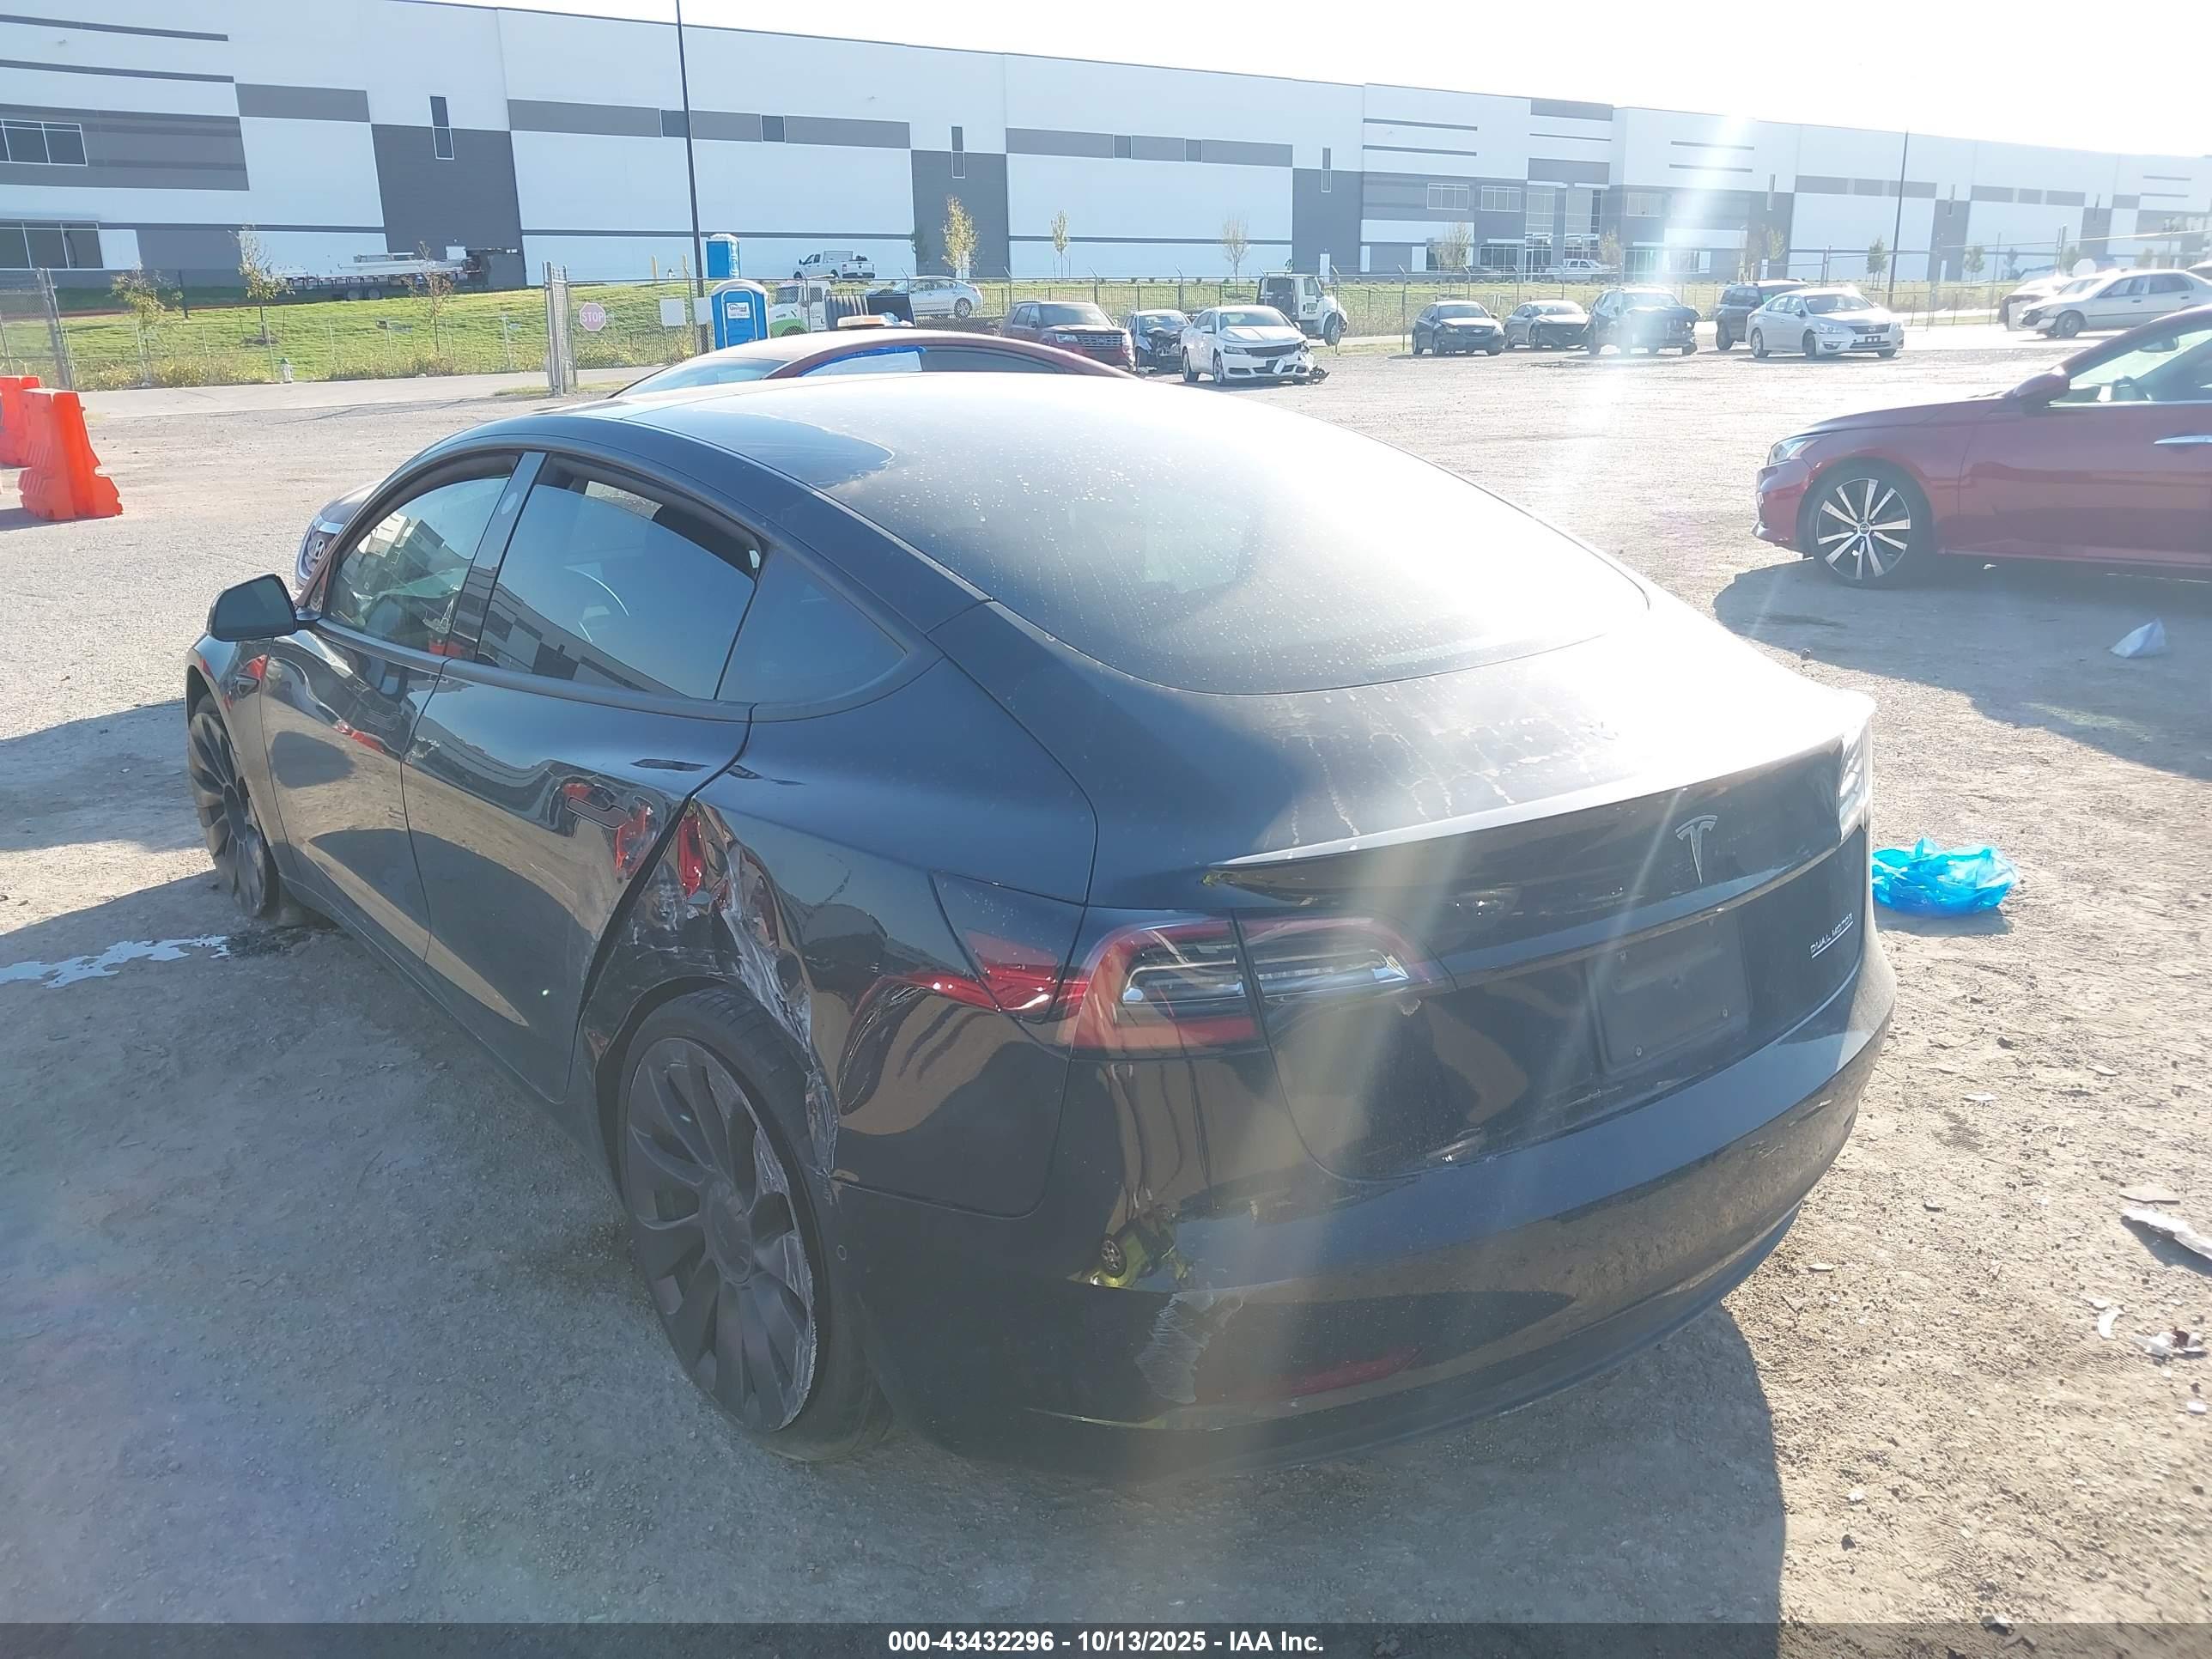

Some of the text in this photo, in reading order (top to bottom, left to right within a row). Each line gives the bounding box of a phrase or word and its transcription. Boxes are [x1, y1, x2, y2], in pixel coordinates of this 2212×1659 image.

[581, 312, 604, 323] STOP
[1810, 913, 1853, 955] DUAL MOTOR
